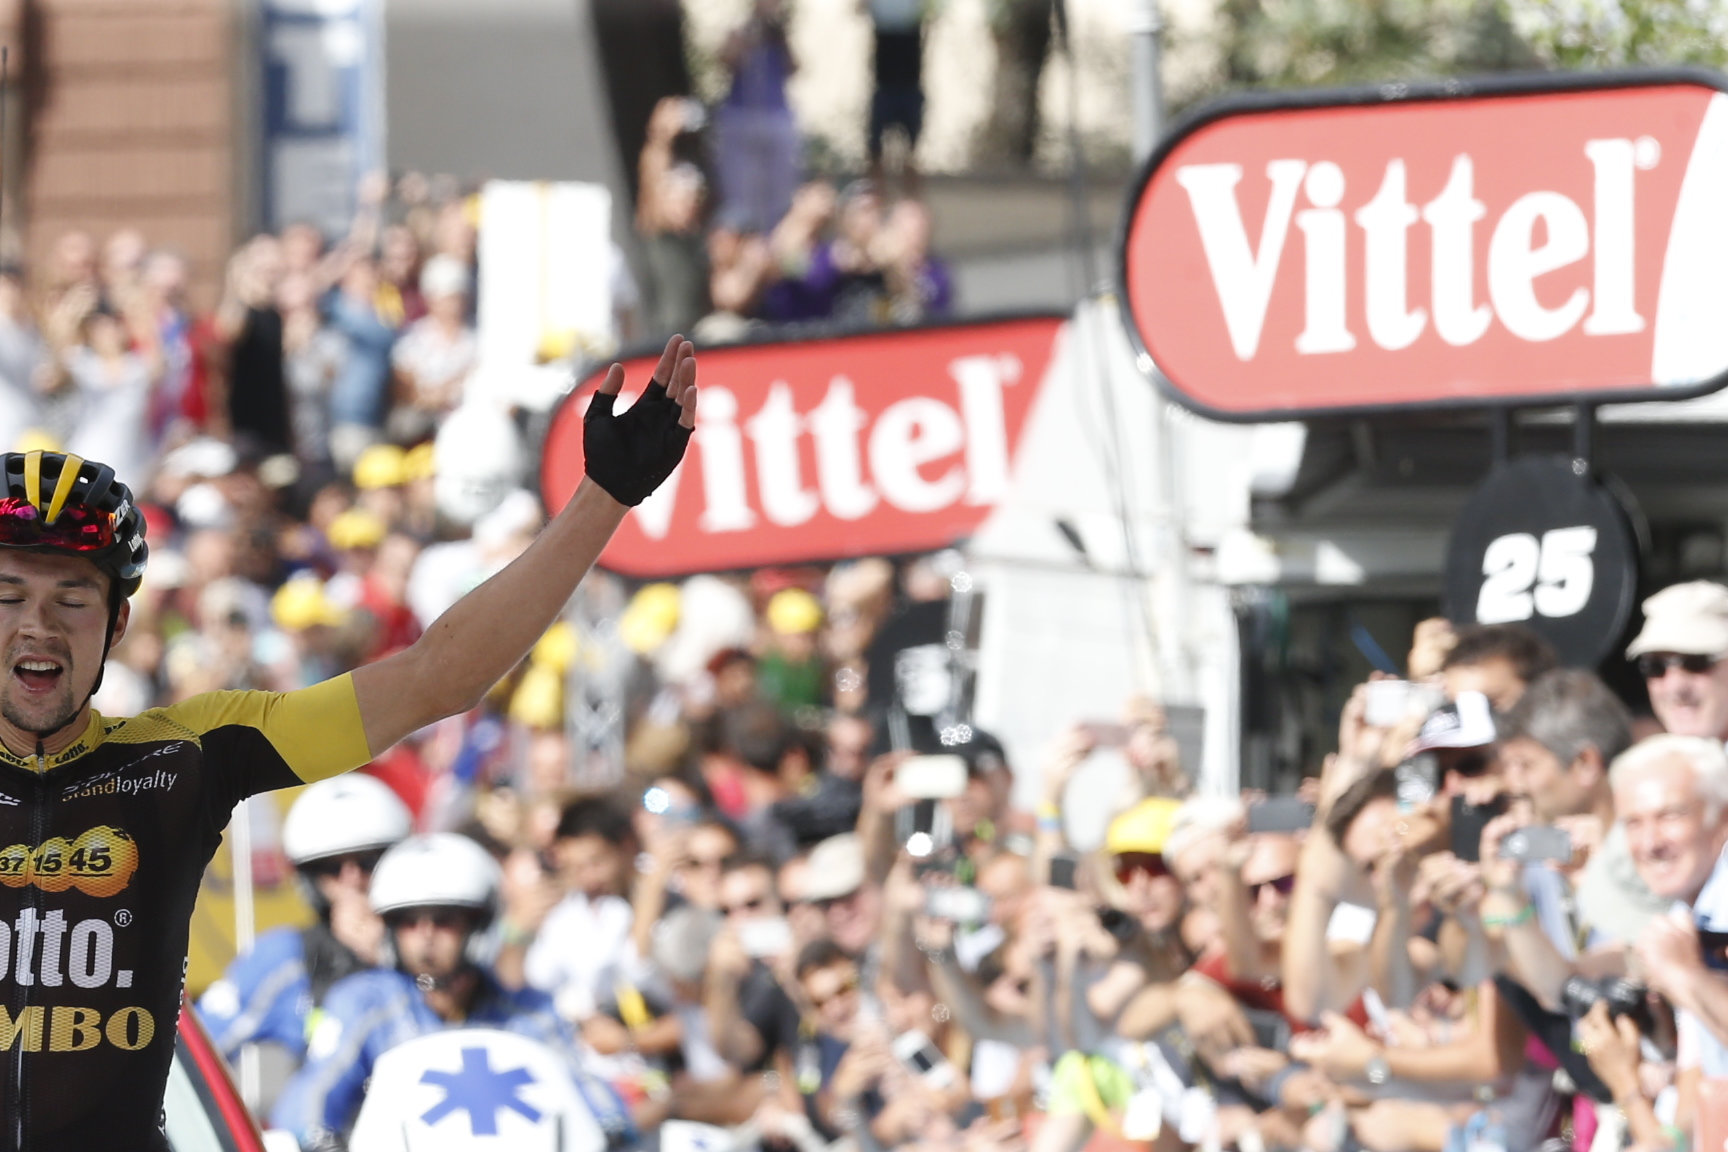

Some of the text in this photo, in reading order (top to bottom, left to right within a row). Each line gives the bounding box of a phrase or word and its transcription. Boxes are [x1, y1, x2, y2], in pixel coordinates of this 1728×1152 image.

[1175, 136, 1646, 362] Vittel
[1476, 525, 1598, 625] 25
[33, 853, 63, 873] 15
[69, 847, 112, 873] 45
